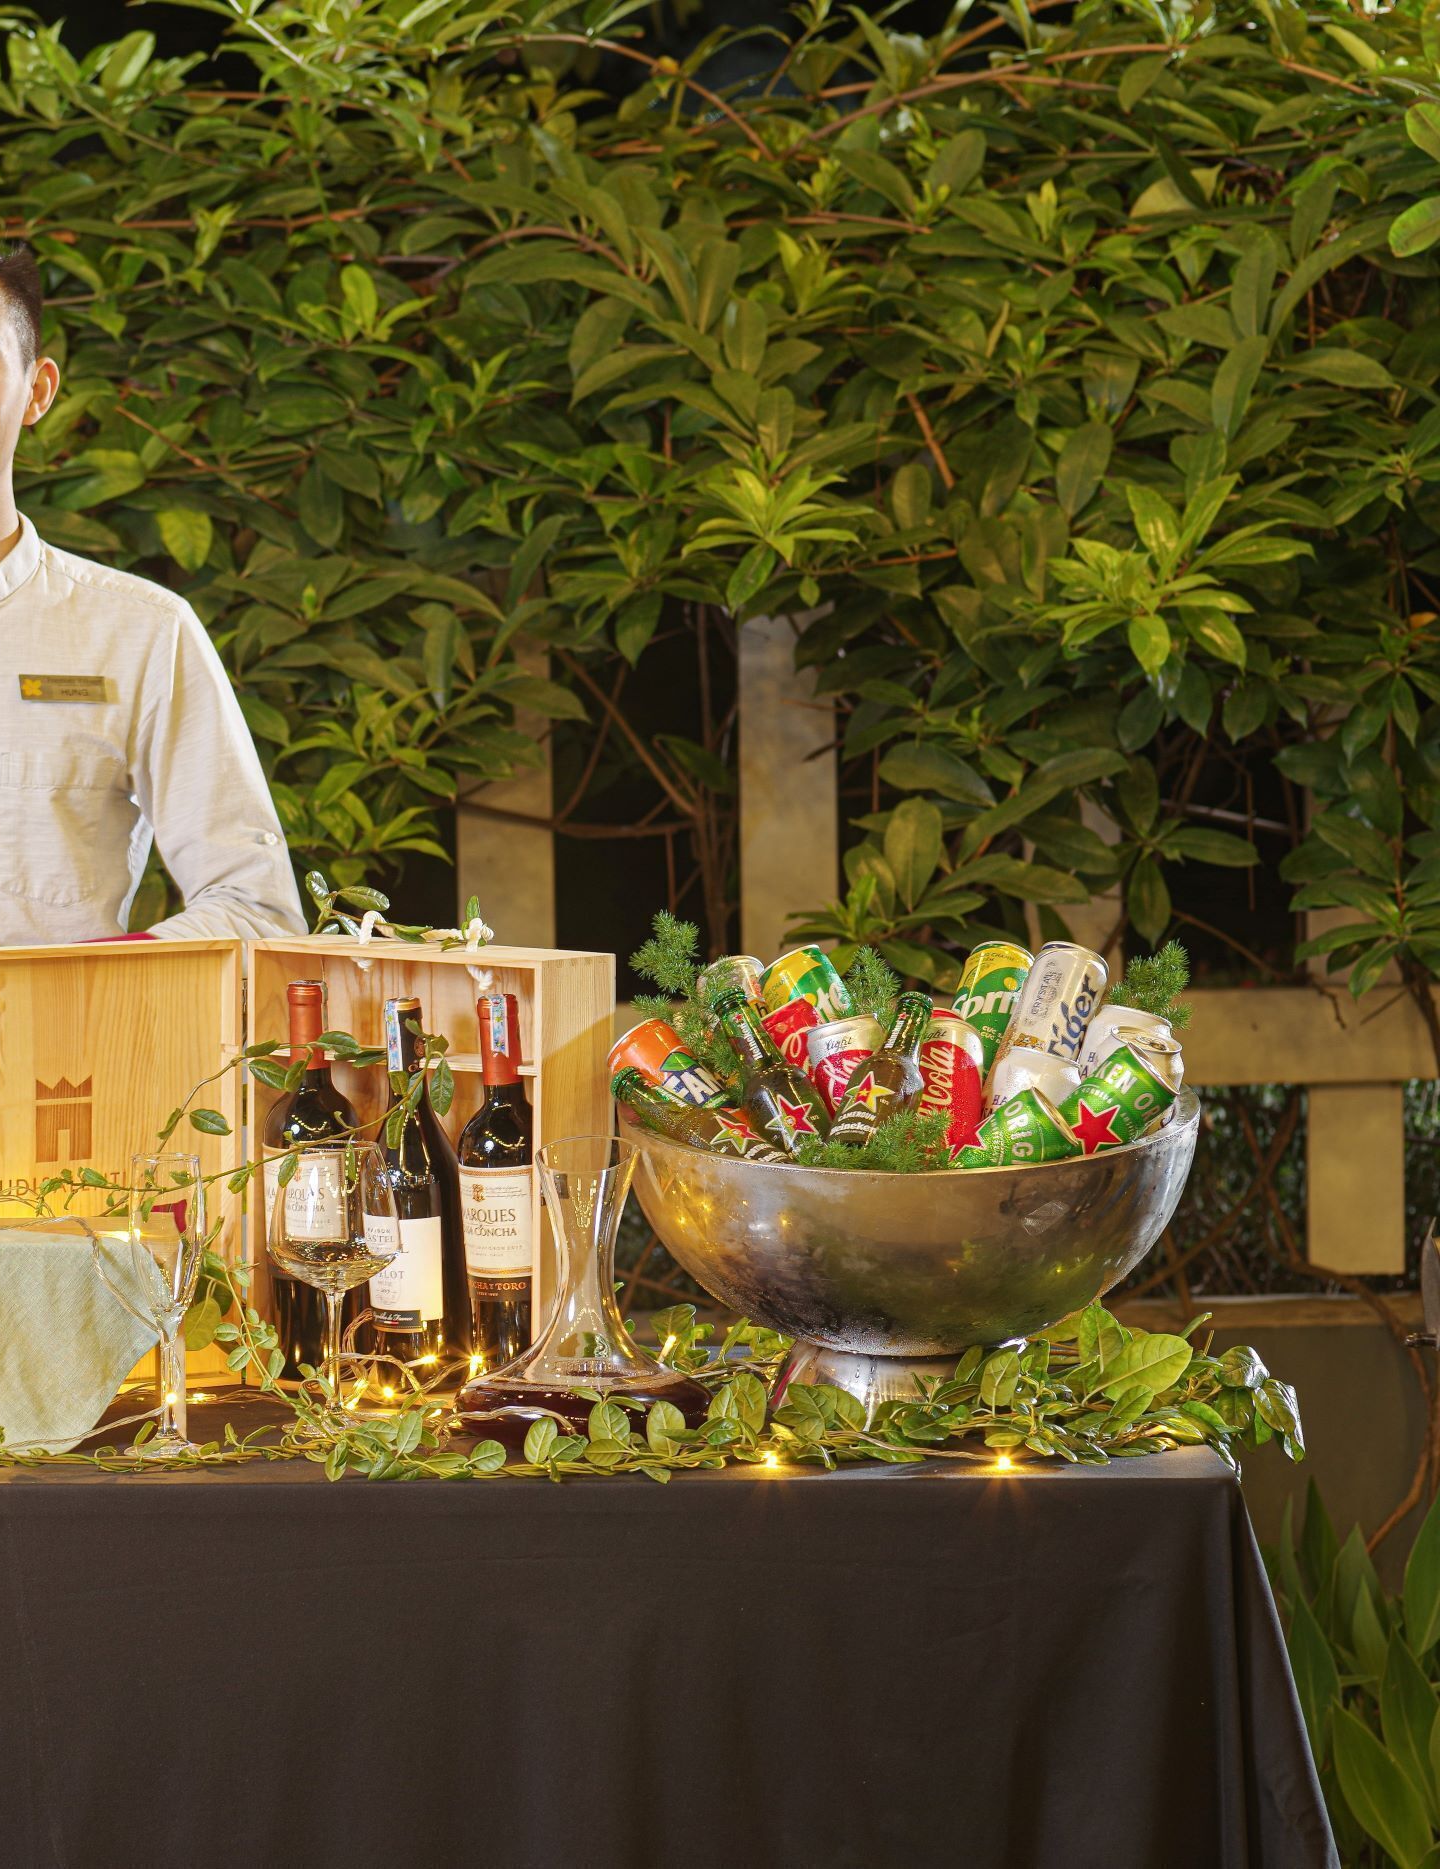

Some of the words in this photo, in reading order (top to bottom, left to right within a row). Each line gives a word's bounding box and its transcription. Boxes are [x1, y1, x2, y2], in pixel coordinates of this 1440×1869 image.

[1047, 974, 1098, 1062] Tiger
[740, 1022, 764, 1061] Heineken
[884, 1019, 905, 1050] Heineken
[837, 1110, 877, 1122] CAMEROUN
[829, 1121, 878, 1137] Heineken
[494, 1281, 527, 1291] TORO
